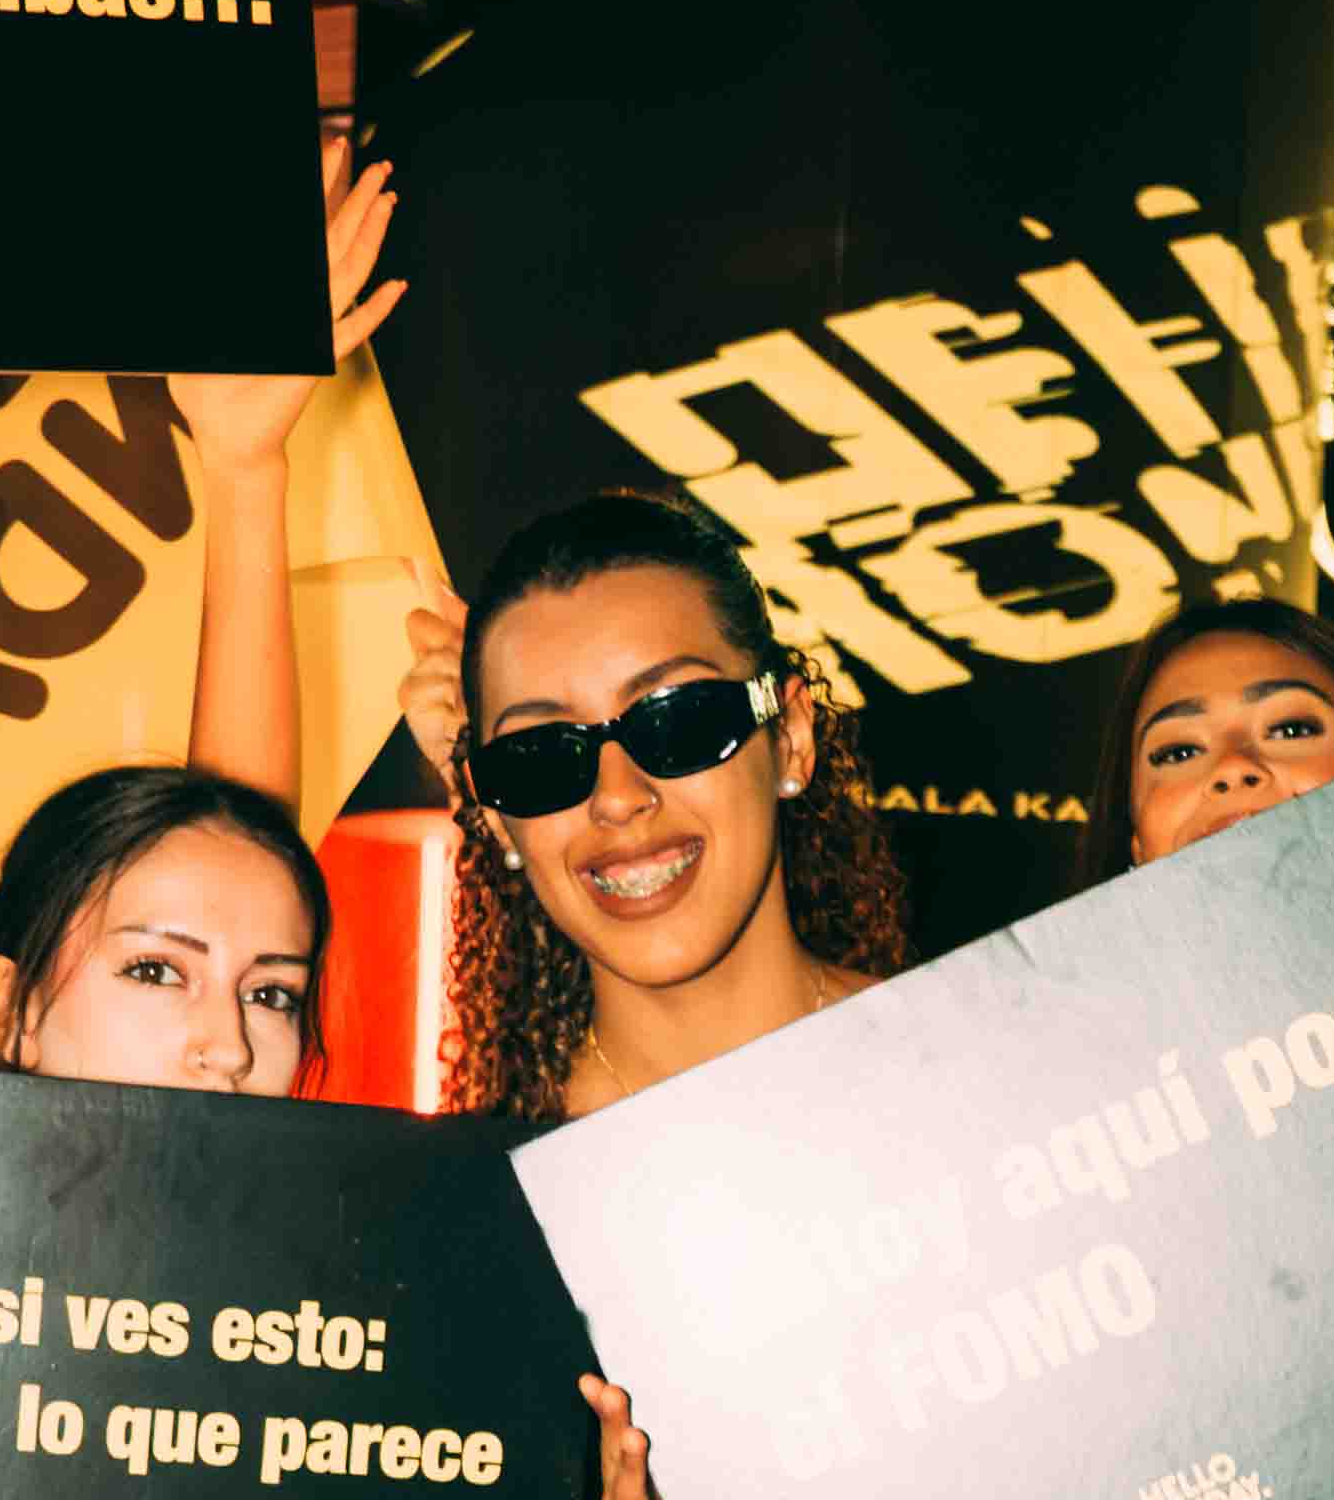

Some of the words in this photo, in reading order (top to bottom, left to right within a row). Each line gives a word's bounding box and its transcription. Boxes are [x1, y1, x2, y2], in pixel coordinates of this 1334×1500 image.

[1014, 790, 1091, 823] KA
[996, 1049, 1211, 1219] aquí
[66, 1296, 190, 1359] ves
[211, 1302, 387, 1373] esto:
[874, 1243, 1158, 1432] FOMO
[16, 1384, 84, 1456] lo
[105, 1403, 242, 1477] que
[260, 1416, 504, 1487] parece
